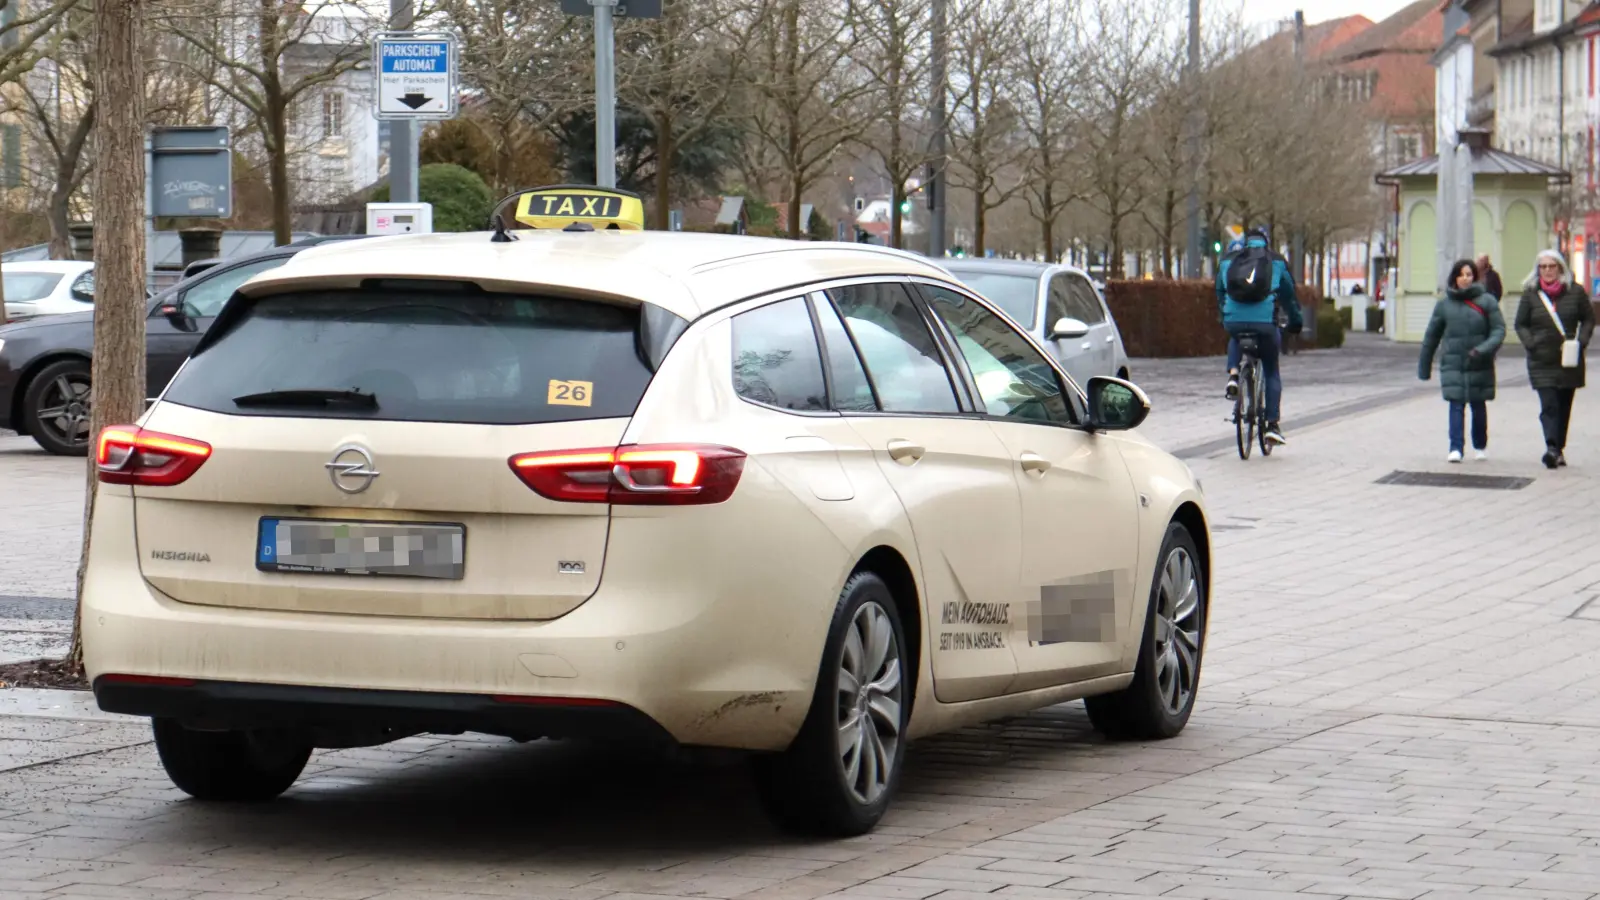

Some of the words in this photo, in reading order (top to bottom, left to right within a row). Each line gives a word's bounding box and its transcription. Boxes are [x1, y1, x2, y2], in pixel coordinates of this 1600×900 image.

[383, 44, 446, 57] PARKSCHEIN-
[393, 59, 436, 71] AUTOMAT
[383, 76, 400, 84] Hier
[403, 76, 446, 84] Parkschein
[542, 196, 611, 216] TAXI
[555, 384, 586, 401] 26
[151, 549, 211, 563] INSIGNIA
[264, 545, 272, 556] D
[942, 601, 960, 625] MEIN
[940, 632, 953, 651] SEIT
[965, 632, 973, 650] IN
